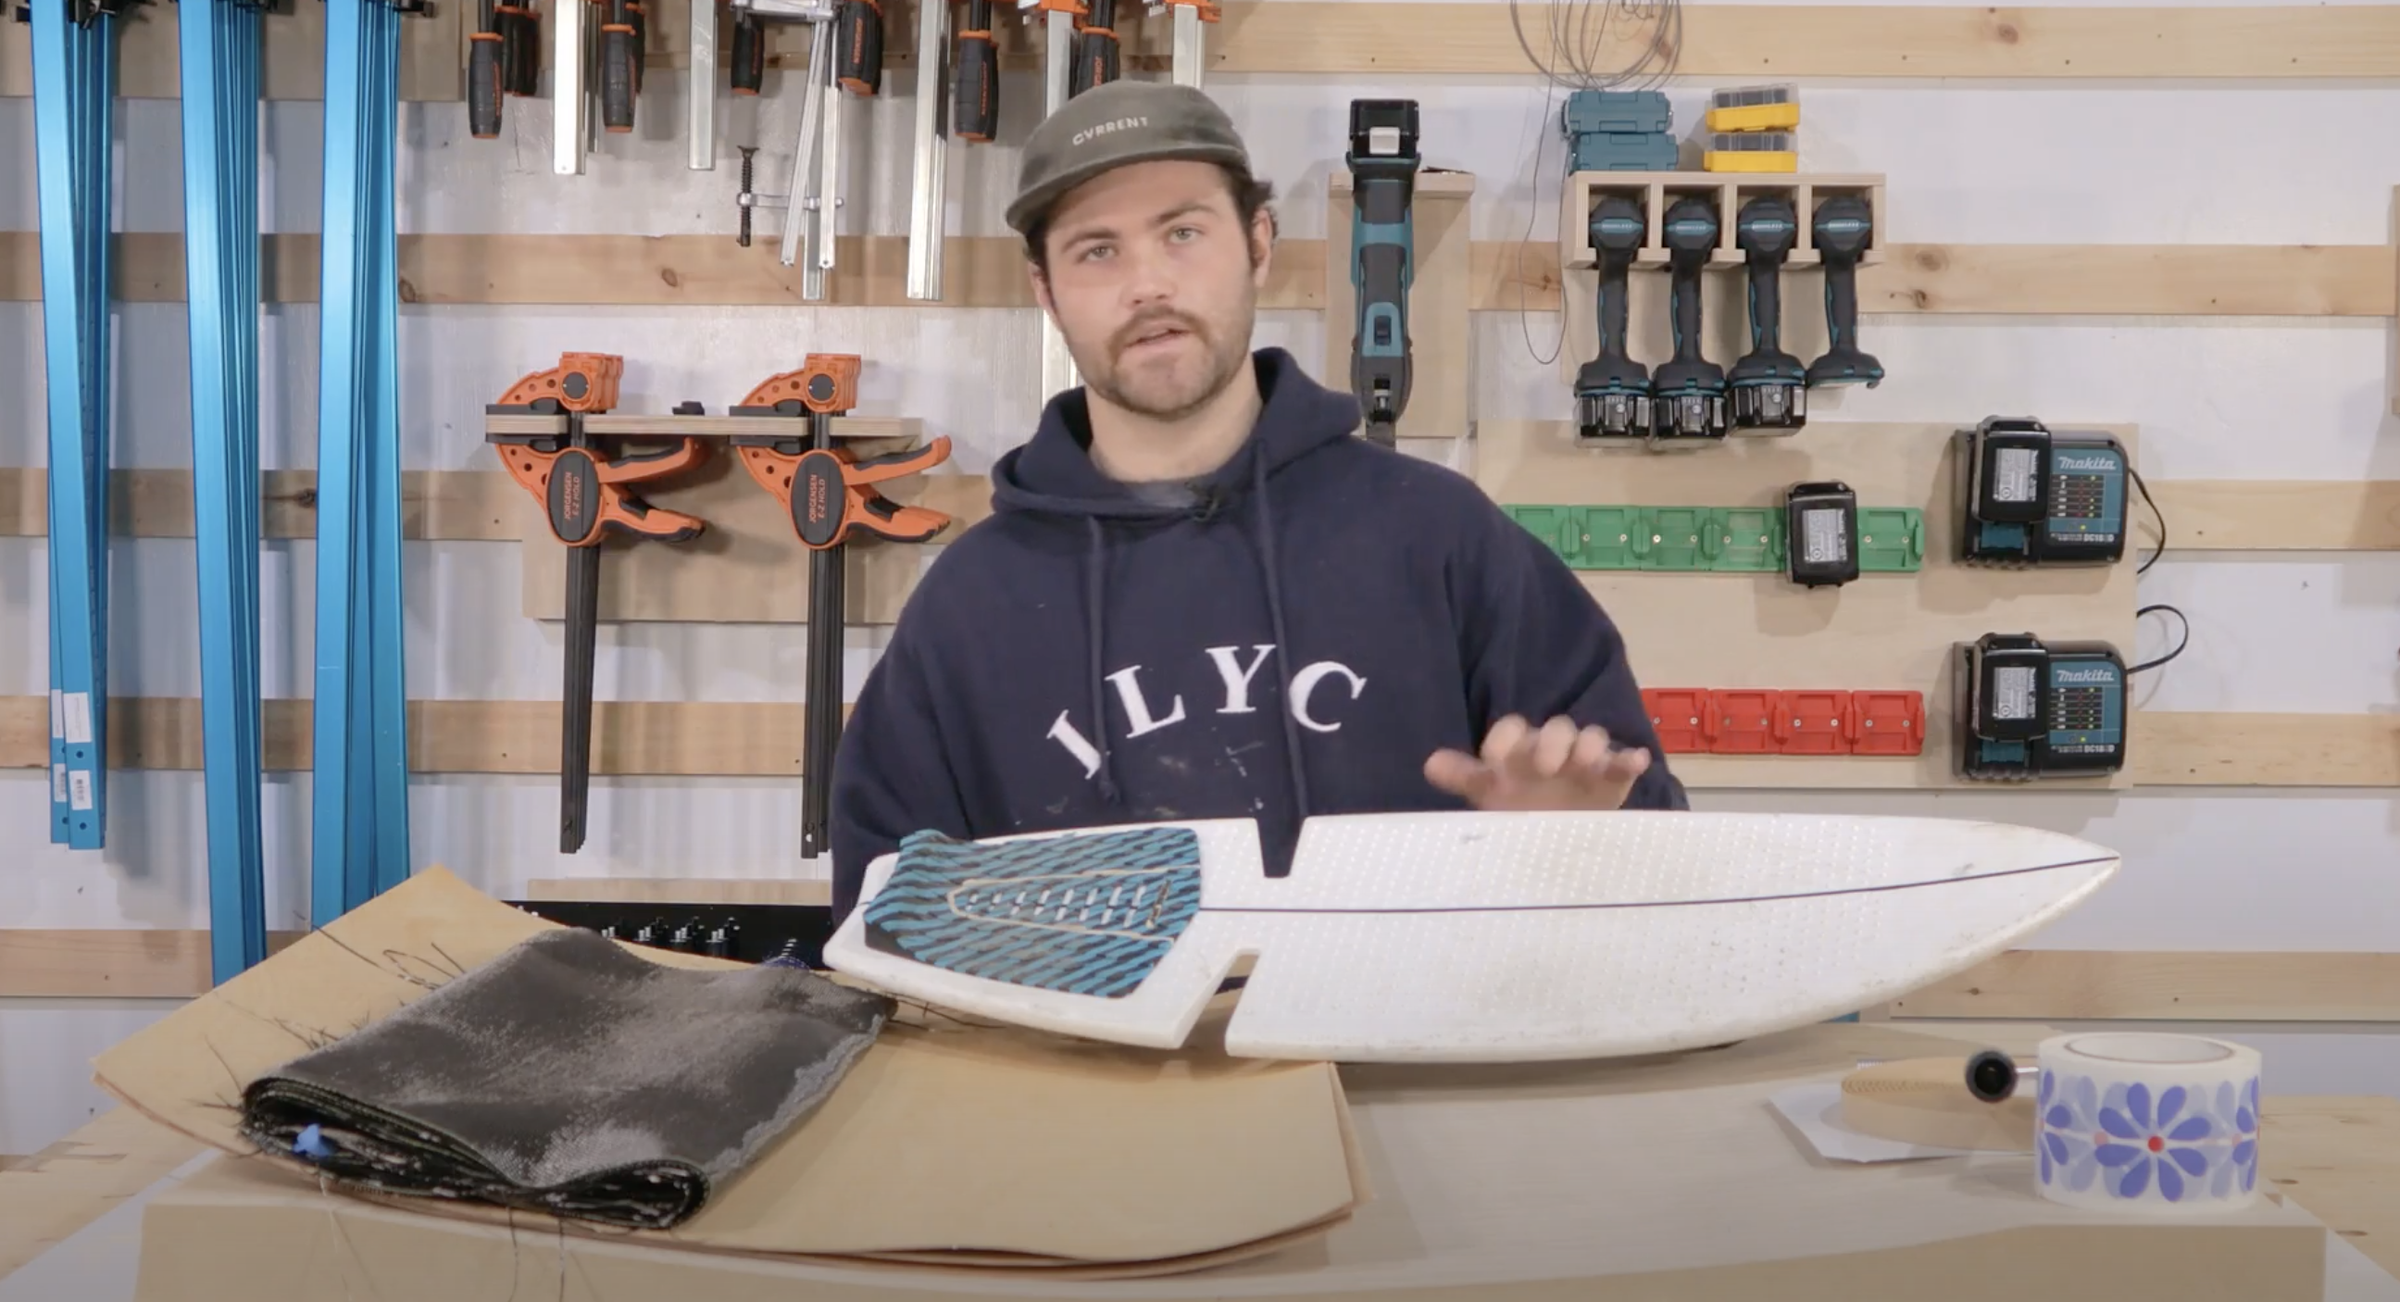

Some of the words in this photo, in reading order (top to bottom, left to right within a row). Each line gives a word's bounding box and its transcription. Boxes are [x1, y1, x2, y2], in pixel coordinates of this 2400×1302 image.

[1094, 56, 1104, 87] JORGE
[564, 472, 572, 520] JORGENSEN
[809, 474, 818, 523] JORGENSEN
[818, 478, 826, 503] HOLD
